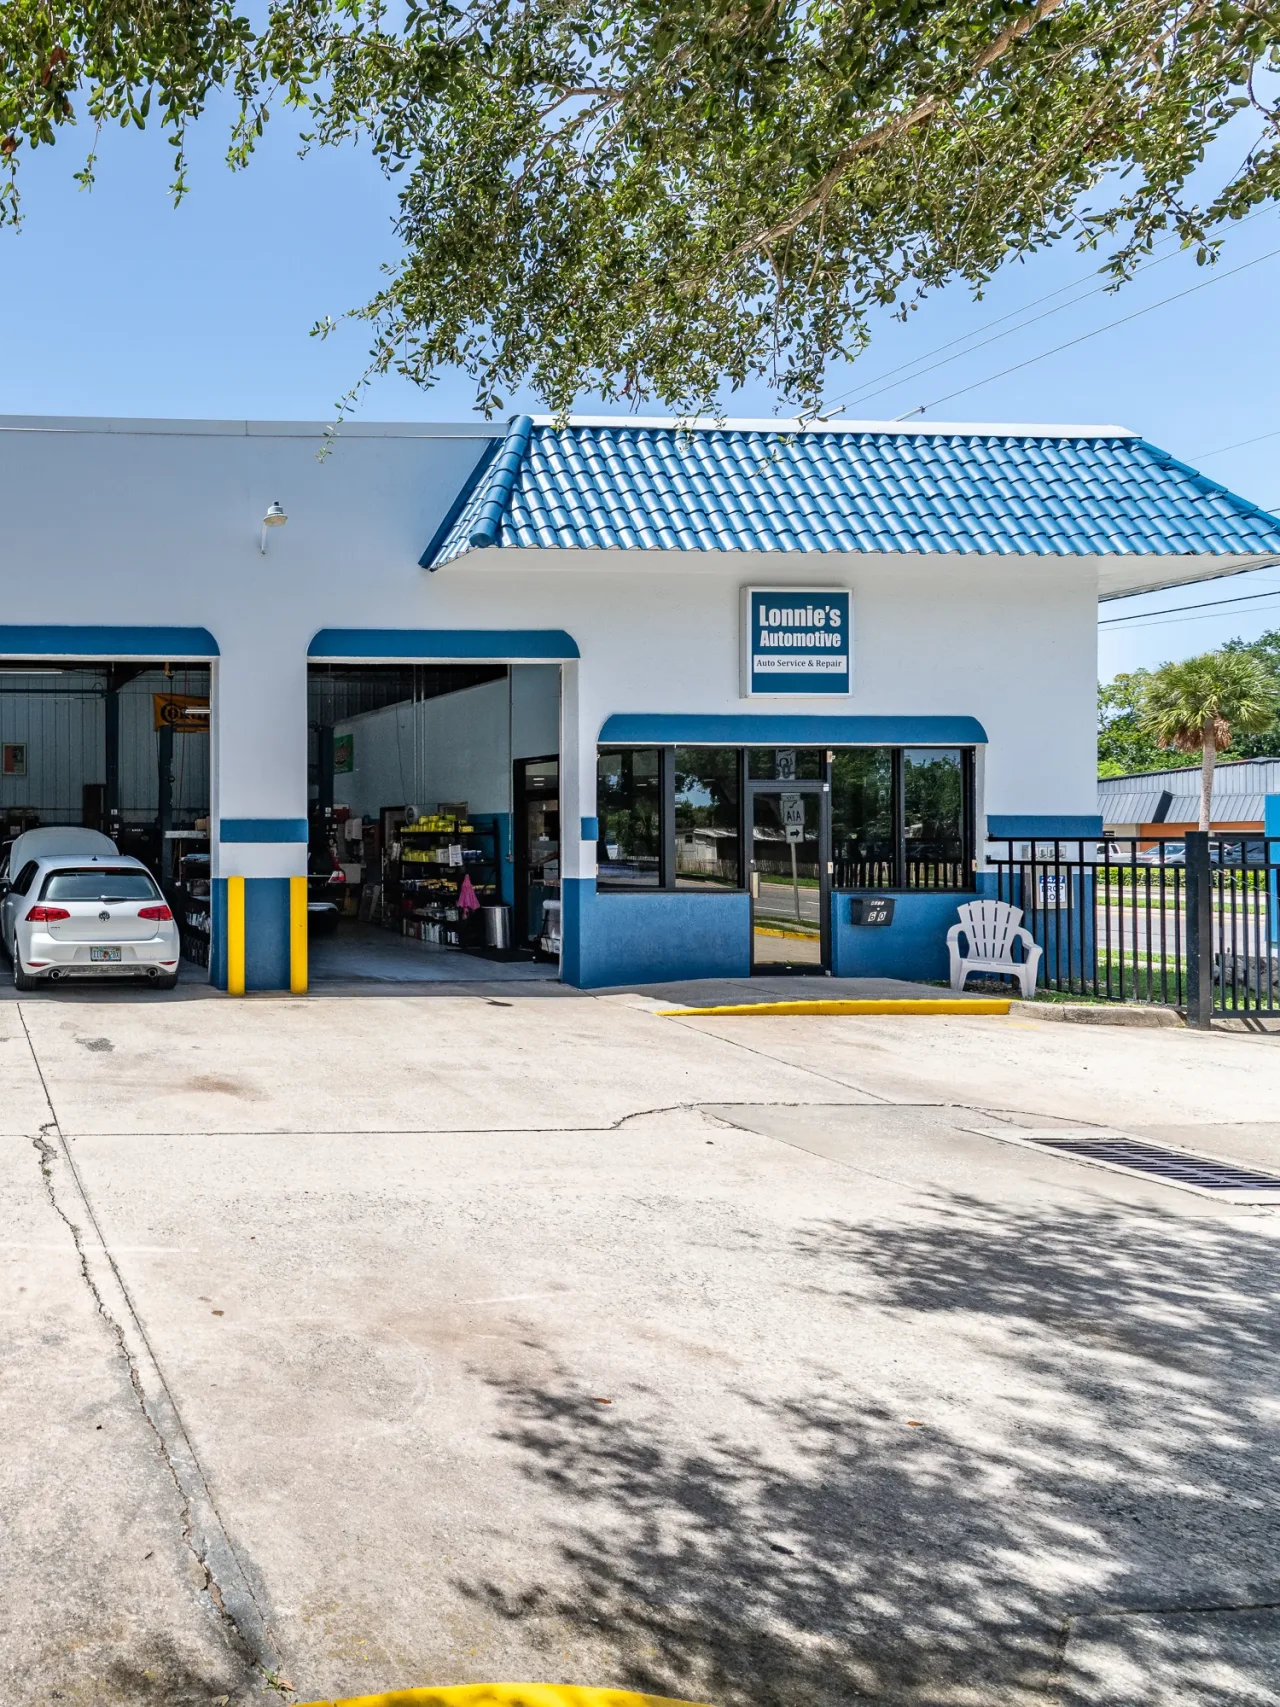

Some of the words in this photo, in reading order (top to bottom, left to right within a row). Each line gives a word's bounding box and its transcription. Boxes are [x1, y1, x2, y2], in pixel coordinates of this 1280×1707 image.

[759, 605, 842, 627] Lonnie's
[759, 630, 842, 648] Automotive
[756, 659, 776, 667] Auto
[776, 659, 807, 667] Service
[807, 659, 814, 667] &
[815, 659, 843, 669] Repair
